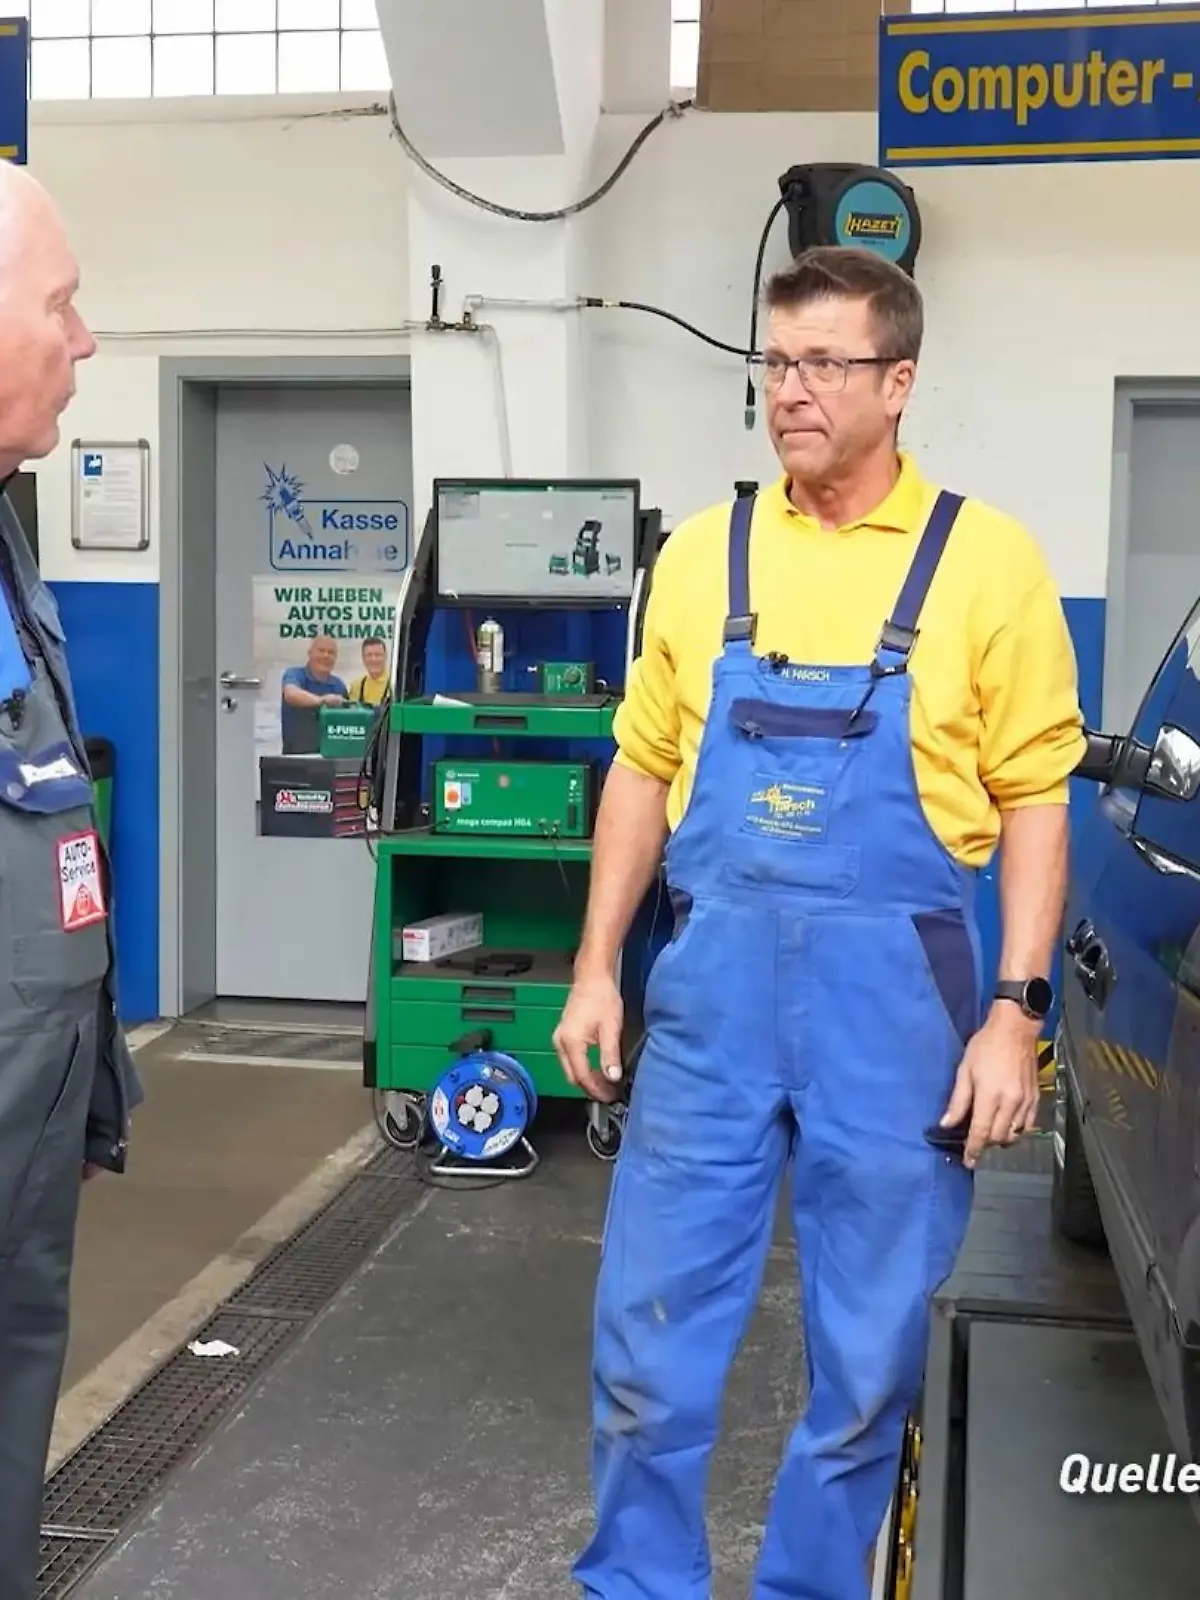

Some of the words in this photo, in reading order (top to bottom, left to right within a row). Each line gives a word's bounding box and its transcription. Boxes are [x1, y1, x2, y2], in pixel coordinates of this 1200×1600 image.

[849, 217, 897, 232] HAZET
[322, 508, 399, 531] Kasse
[279, 539, 399, 560] Annahe
[274, 587, 312, 603] WIR
[317, 588, 383, 603] LIEBEN
[287, 605, 353, 621] AUTOS
[279, 623, 317, 638] DAS
[323, 623, 393, 639] KLIMA!
[327, 725, 367, 735] E-FUELS
